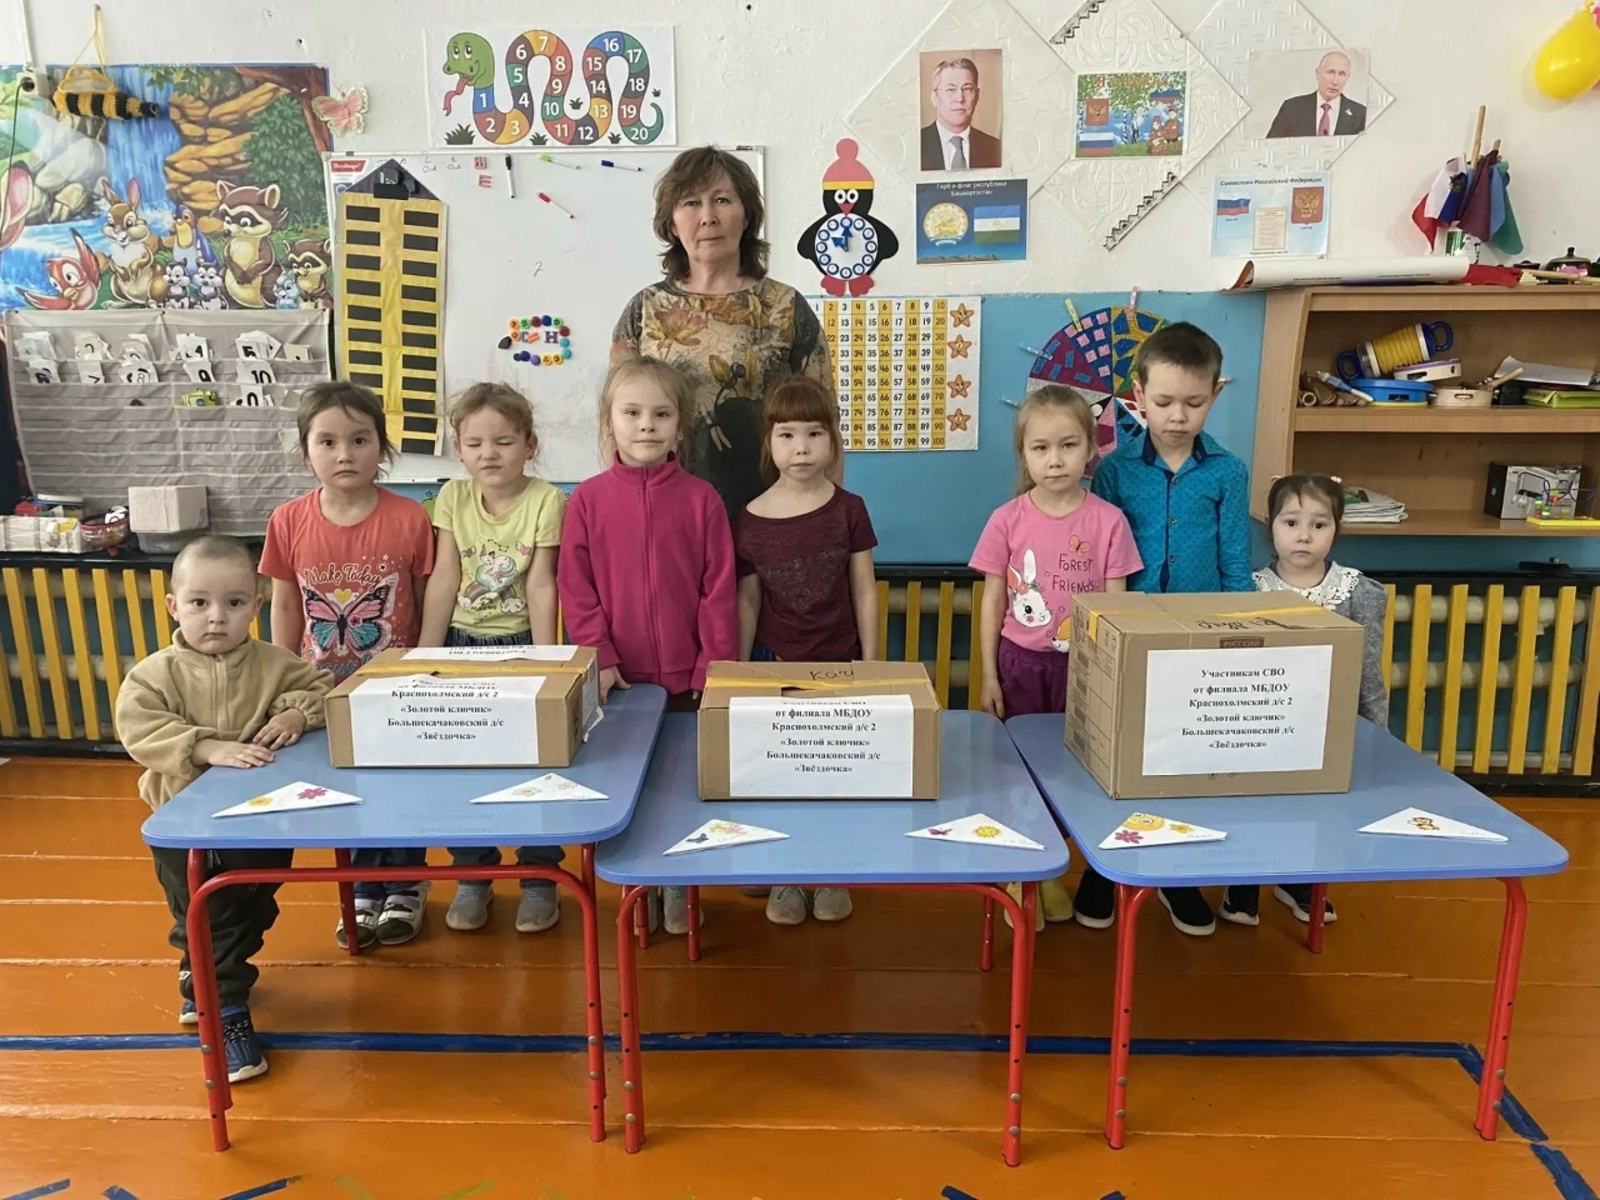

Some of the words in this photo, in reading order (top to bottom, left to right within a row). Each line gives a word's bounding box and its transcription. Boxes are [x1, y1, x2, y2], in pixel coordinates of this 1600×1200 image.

[538, 36, 549, 51] 7
[604, 38, 620, 52] 16
[516, 45, 526, 60] 6
[627, 50, 642, 64] 17
[555, 56, 566, 70] 8
[586, 57, 603, 71] 15
[513, 68, 523, 83] 5
[552, 79, 562, 94] 9
[590, 80, 606, 94] 14
[629, 77, 645, 91] 18
[479, 94, 487, 107] 1
[519, 93, 529, 107] 4
[544, 102, 560, 116] 10
[593, 104, 608, 118] 13
[621, 105, 637, 118] 19
[485, 118, 495, 132] 2
[510, 121, 520, 135] 3
[555, 123, 569, 137] 11
[578, 127, 594, 141] 12
[631, 126, 648, 140] 20
[937, 301, 945, 310] 10
[828, 318, 835, 327] 12
[841, 318, 849, 327] 13
[869, 318, 877, 327] 15
[881, 318, 889, 327] 16
[895, 318, 903, 326] 17
[909, 317, 917, 326] 18
[923, 317, 931, 325] 19
[935, 317, 945, 325] 20
[840, 334, 849, 342] 23
[867, 334, 877, 342] 25
[879, 334, 890, 342] 26
[894, 333, 903, 342] 27
[908, 333, 917, 342] 28
[921, 333, 931, 341] 29
[935, 333, 945, 341] 30
[840, 349, 850, 358] 33
[867, 349, 877, 357] 35
[879, 349, 889, 357] 36
[894, 349, 903, 357] 37
[908, 349, 917, 357] 38
[921, 348, 931, 357] 39
[935, 348, 945, 356] 40
[840, 365, 849, 373] 43
[867, 364, 877, 373] 45
[893, 364, 903, 372] 47
[907, 364, 917, 372] 48
[921, 364, 930, 372] 49
[935, 363, 944, 372] 50
[840, 379, 849, 387] 53
[867, 378, 877, 387] 55
[880, 378, 889, 386] 56
[894, 378, 903, 386] 57
[907, 378, 917, 386] 58
[921, 377, 930, 386] 59
[935, 377, 944, 385] 60
[840, 394, 849, 402] 63
[867, 393, 876, 402] 65
[880, 393, 889, 401] 66
[893, 393, 903, 401] 67
[907, 393, 917, 401] 68
[921, 392, 930, 401] 69
[935, 392, 944, 400] 70
[840, 408, 849, 417] 73
[867, 408, 876, 417] 75
[880, 408, 889, 417] 76
[894, 408, 903, 416] 77
[907, 408, 916, 416] 78
[921, 407, 930, 415] 79
[840, 423, 849, 432] 83
[867, 423, 876, 431] 85
[893, 423, 903, 431] 87
[920, 422, 930, 430] 89
[934, 422, 944, 430] 90
[867, 438, 876, 446] 95
[893, 438, 903, 446] 97
[920, 437, 930, 445] 99
[933, 437, 945, 445] 100
[304, 562, 342, 587] Make
[342, 563, 381, 592] Today
[1201, 669, 1260, 678] Участникам
[1262, 668, 1285, 677] СВО
[391, 690, 474, 699] Краснохолмский
[476, 690, 490, 699] д/с
[492, 690, 498, 698] 2
[1206, 685, 1249, 696] филиала
[1250, 683, 1290, 694] МБДОУ
[1189, 698, 1270, 708] Краснохолмский
[1272, 698, 1285, 707] д/с
[1287, 698, 1292, 706] 2
[401, 704, 445, 713] «Золотой
[449, 705, 492, 713] ключик»
[788, 708, 830, 719] филиала
[833, 708, 874, 719] МБДОУ
[388, 718, 488, 727] Большекачаковский
[491, 718, 504, 728] д/с
[1197, 713, 1240, 723] «Золотой
[1243, 714, 1285, 722] ключик»
[772, 722, 853, 732] Краснохолмский
[855, 723, 868, 732] д/с
[871, 723, 876, 731] 2
[1182, 726, 1279, 736] Большекачаковский
[1281, 726, 1295, 736] д/с
[417, 732, 476, 741] «Звёздочка»
[780, 738, 824, 747] «Золотой
[827, 739, 870, 747] ключик»
[1209, 739, 1267, 749] «Звёздочка»
[766, 751, 865, 761] Большекачаковский
[867, 752, 880, 760] д/с
[795, 764, 853, 774] «Звёздочка»
